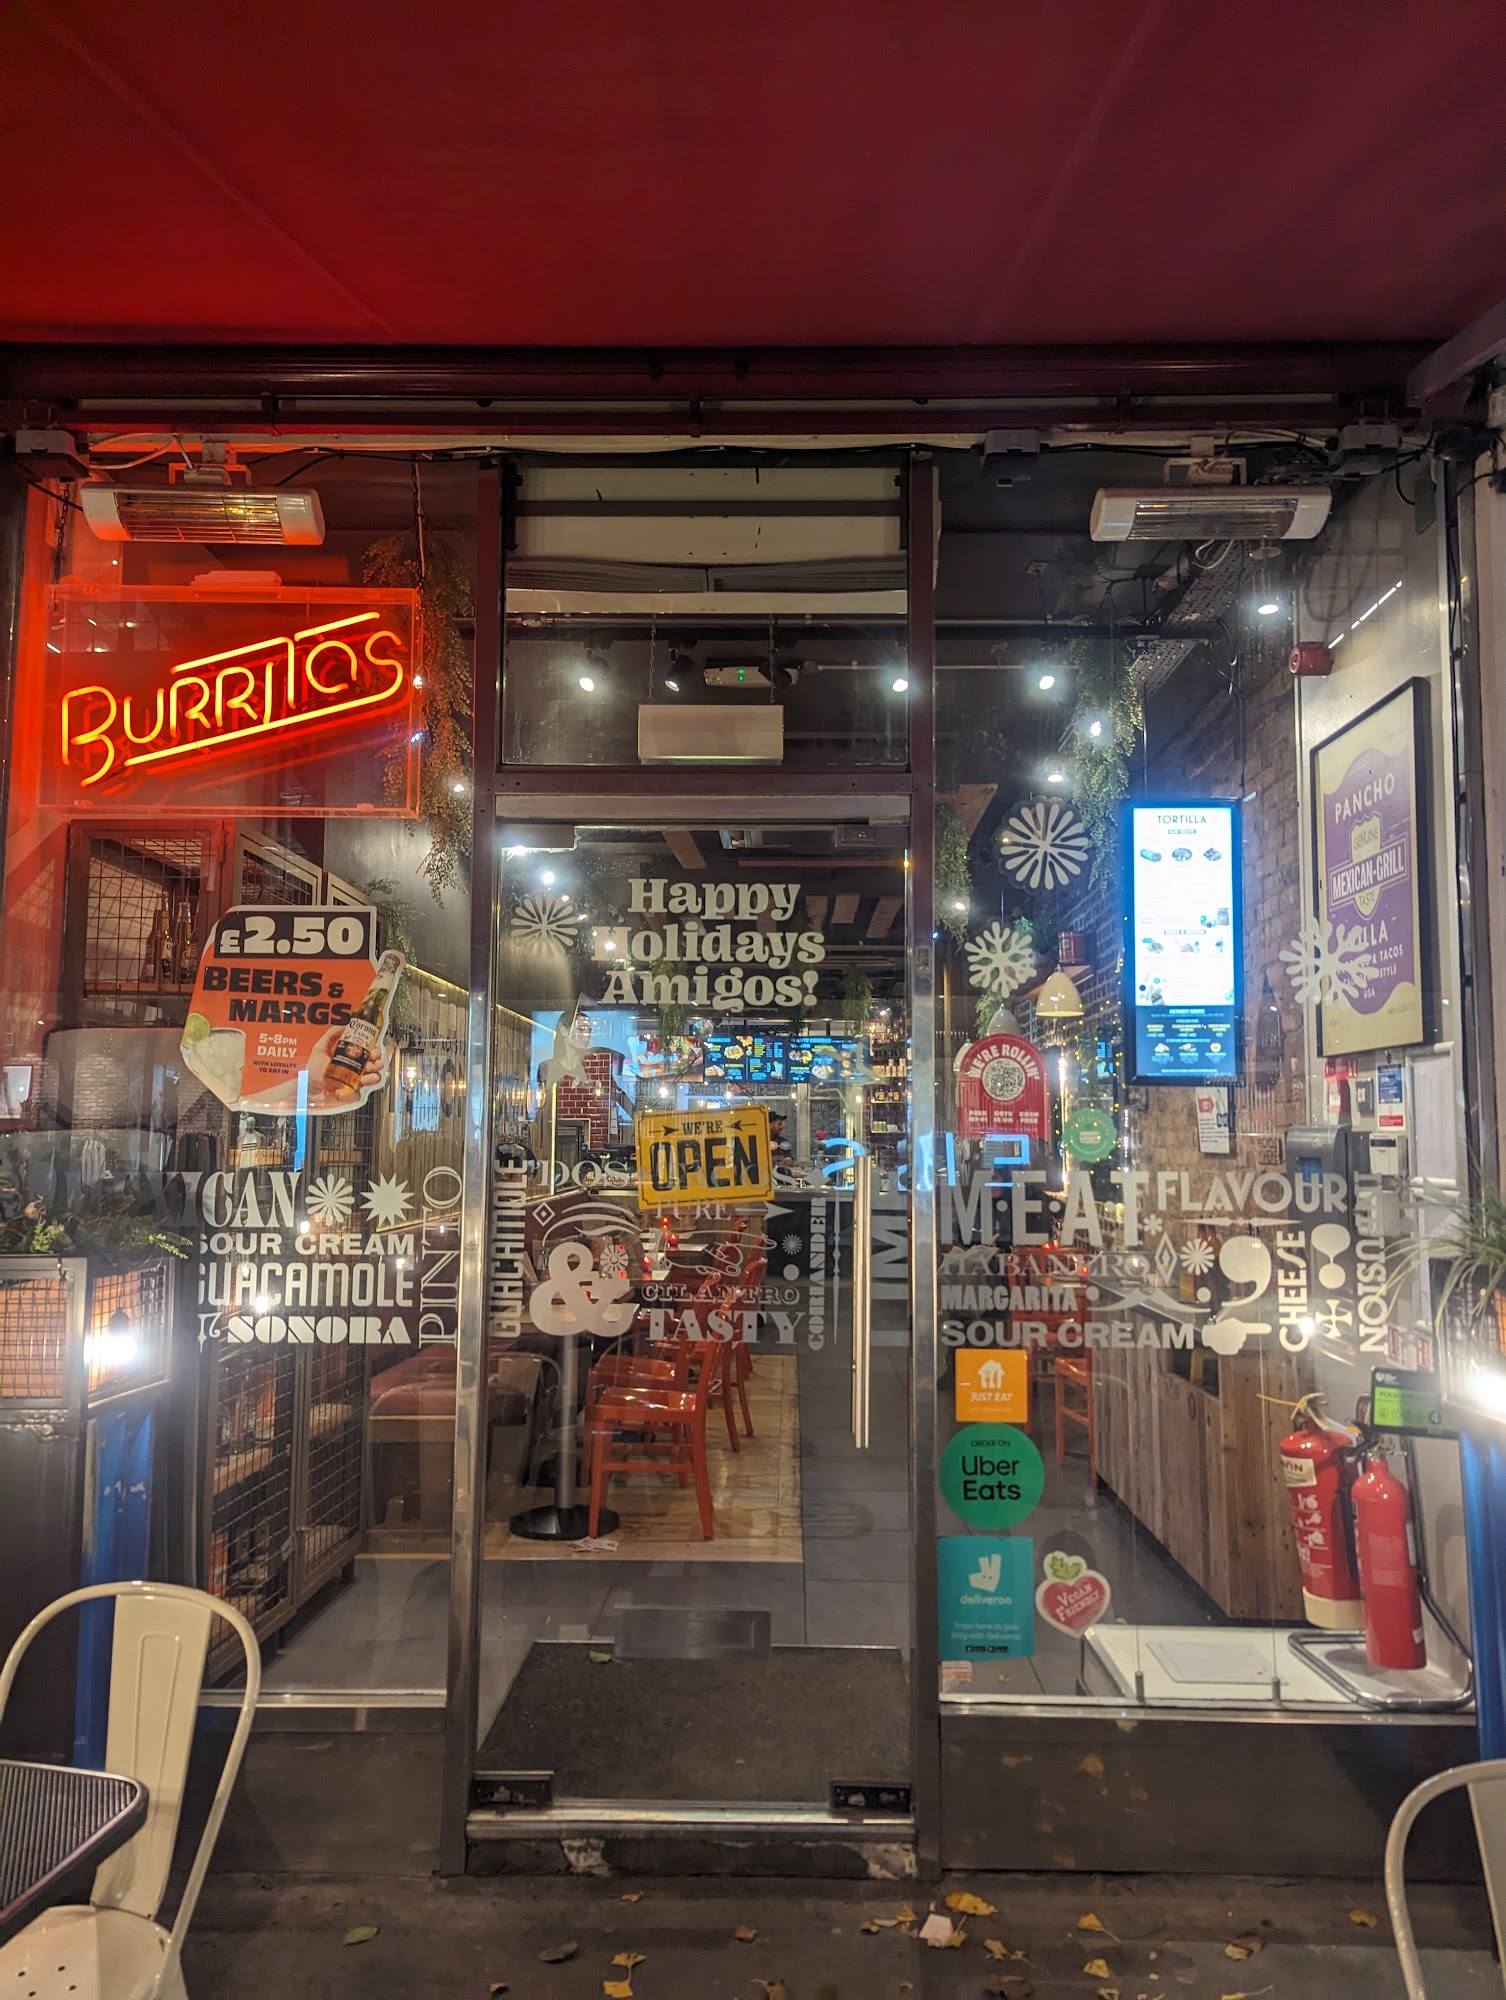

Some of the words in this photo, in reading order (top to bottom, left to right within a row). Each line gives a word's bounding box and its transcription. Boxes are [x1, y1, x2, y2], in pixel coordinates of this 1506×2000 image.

[61, 611, 404, 787] BURRITOS
[1335, 772, 1394, 824] PANCHO
[1157, 815, 1207, 824] TORTILLA
[627, 878, 801, 921] Happy
[1359, 891, 1375, 906] TASTE
[220, 917, 366, 955] £2.50
[591, 922, 825, 970] Holidays
[1380, 944, 1403, 961] TACOS
[203, 966, 324, 997] BEERS
[327, 981, 345, 998] &
[600, 966, 819, 1013] Amigos!
[1363, 988, 1376, 999] USA
[228, 998, 352, 1026] MARGS
[350, 1020, 376, 1038] Corona
[257, 1046, 297, 1058] DAILY
[270, 1061, 297, 1069] LOYALTY
[968, 1045, 999, 1079] WE'RE
[681, 1120, 723, 1136] WE'RE
[537, 1160, 638, 1188] DOS
[650, 1135, 760, 1192] OPEN
[1157, 1171, 1349, 1213] FLAVOUR
[295, 1234, 414, 1256] CREAM
[418, 1165, 463, 1349] PINTO
[490, 1158, 528, 1338] GUACAMOLE
[808, 1197, 827, 1351] CORIANDER
[642, 1285, 800, 1305] CILANTRO
[942, 1284, 1077, 1312] MARGARITA
[1278, 1230, 1309, 1352] CHEESE
[227, 1316, 411, 1344] SONORA
[644, 1307, 804, 1344] TASTY
[941, 1320, 1047, 1349] SOUR
[1058, 1321, 1195, 1349] CREAM
[969, 1392, 992, 1402] JUST
[994, 1392, 1014, 1402] EAT
[970, 1439, 996, 1447] ORDER
[997, 1439, 1011, 1447] ON
[961, 1455, 1020, 1476] Uber
[963, 1480, 1021, 1501] Eats
[960, 1594, 1012, 1605] deliveroo
